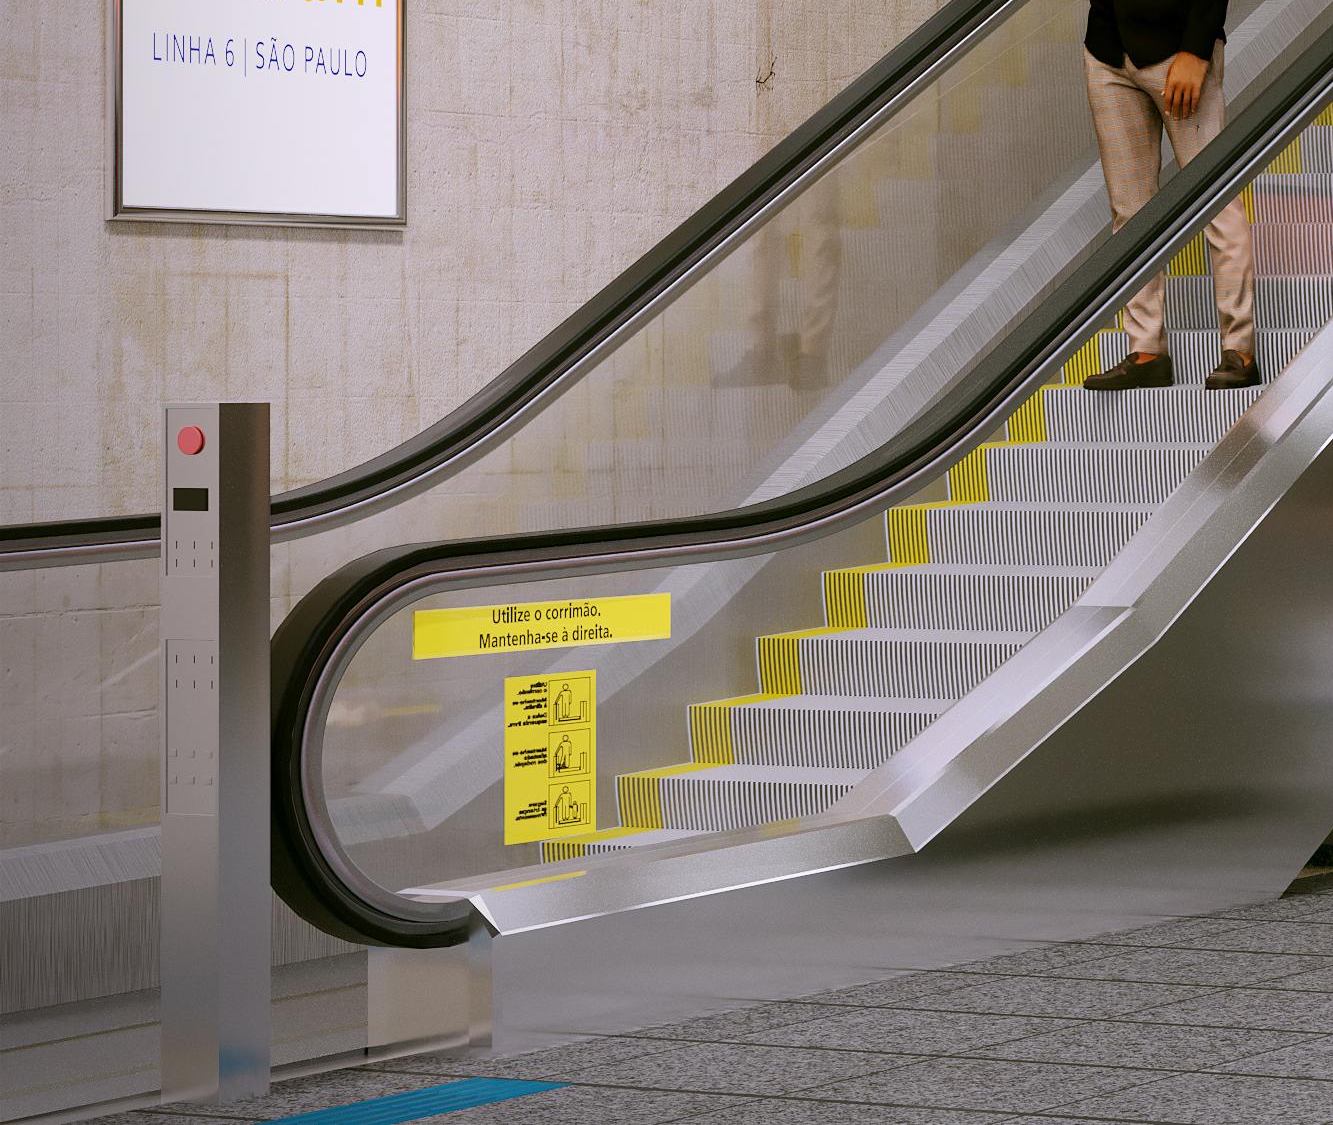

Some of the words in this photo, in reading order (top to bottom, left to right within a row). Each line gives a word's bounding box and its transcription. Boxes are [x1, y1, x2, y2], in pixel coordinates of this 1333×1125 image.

[152, 32, 217, 67] LINHA
[225, 38, 235, 67] 6
[255, 36, 295, 74] SÃO
[304, 45, 367, 78] PAULO
[492, 606, 531, 624] Utilize
[534, 609, 542, 621] o
[545, 602, 601, 620] corrimão.
[479, 629, 558, 649] Mantenha-se
[561, 627, 568, 642] à
[572, 624, 613, 641] direita.
